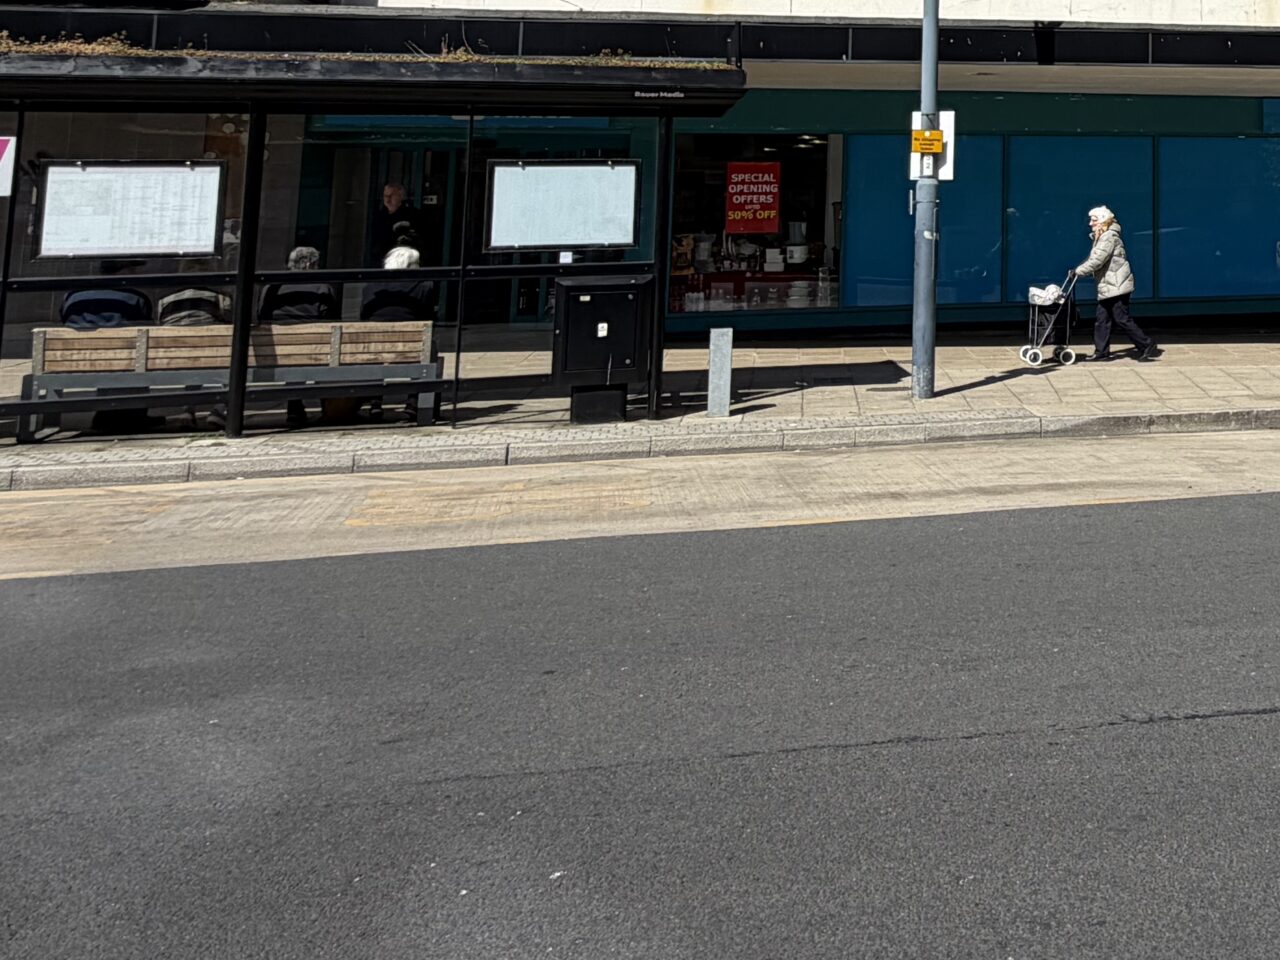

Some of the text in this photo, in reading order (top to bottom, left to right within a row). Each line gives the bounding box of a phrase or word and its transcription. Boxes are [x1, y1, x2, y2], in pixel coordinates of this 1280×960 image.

[731, 173, 777, 182] SPECIAL
[728, 184, 778, 193] OPENING
[732, 194, 774, 204] OFFERS
[728, 210, 777, 220] 50% OFF
